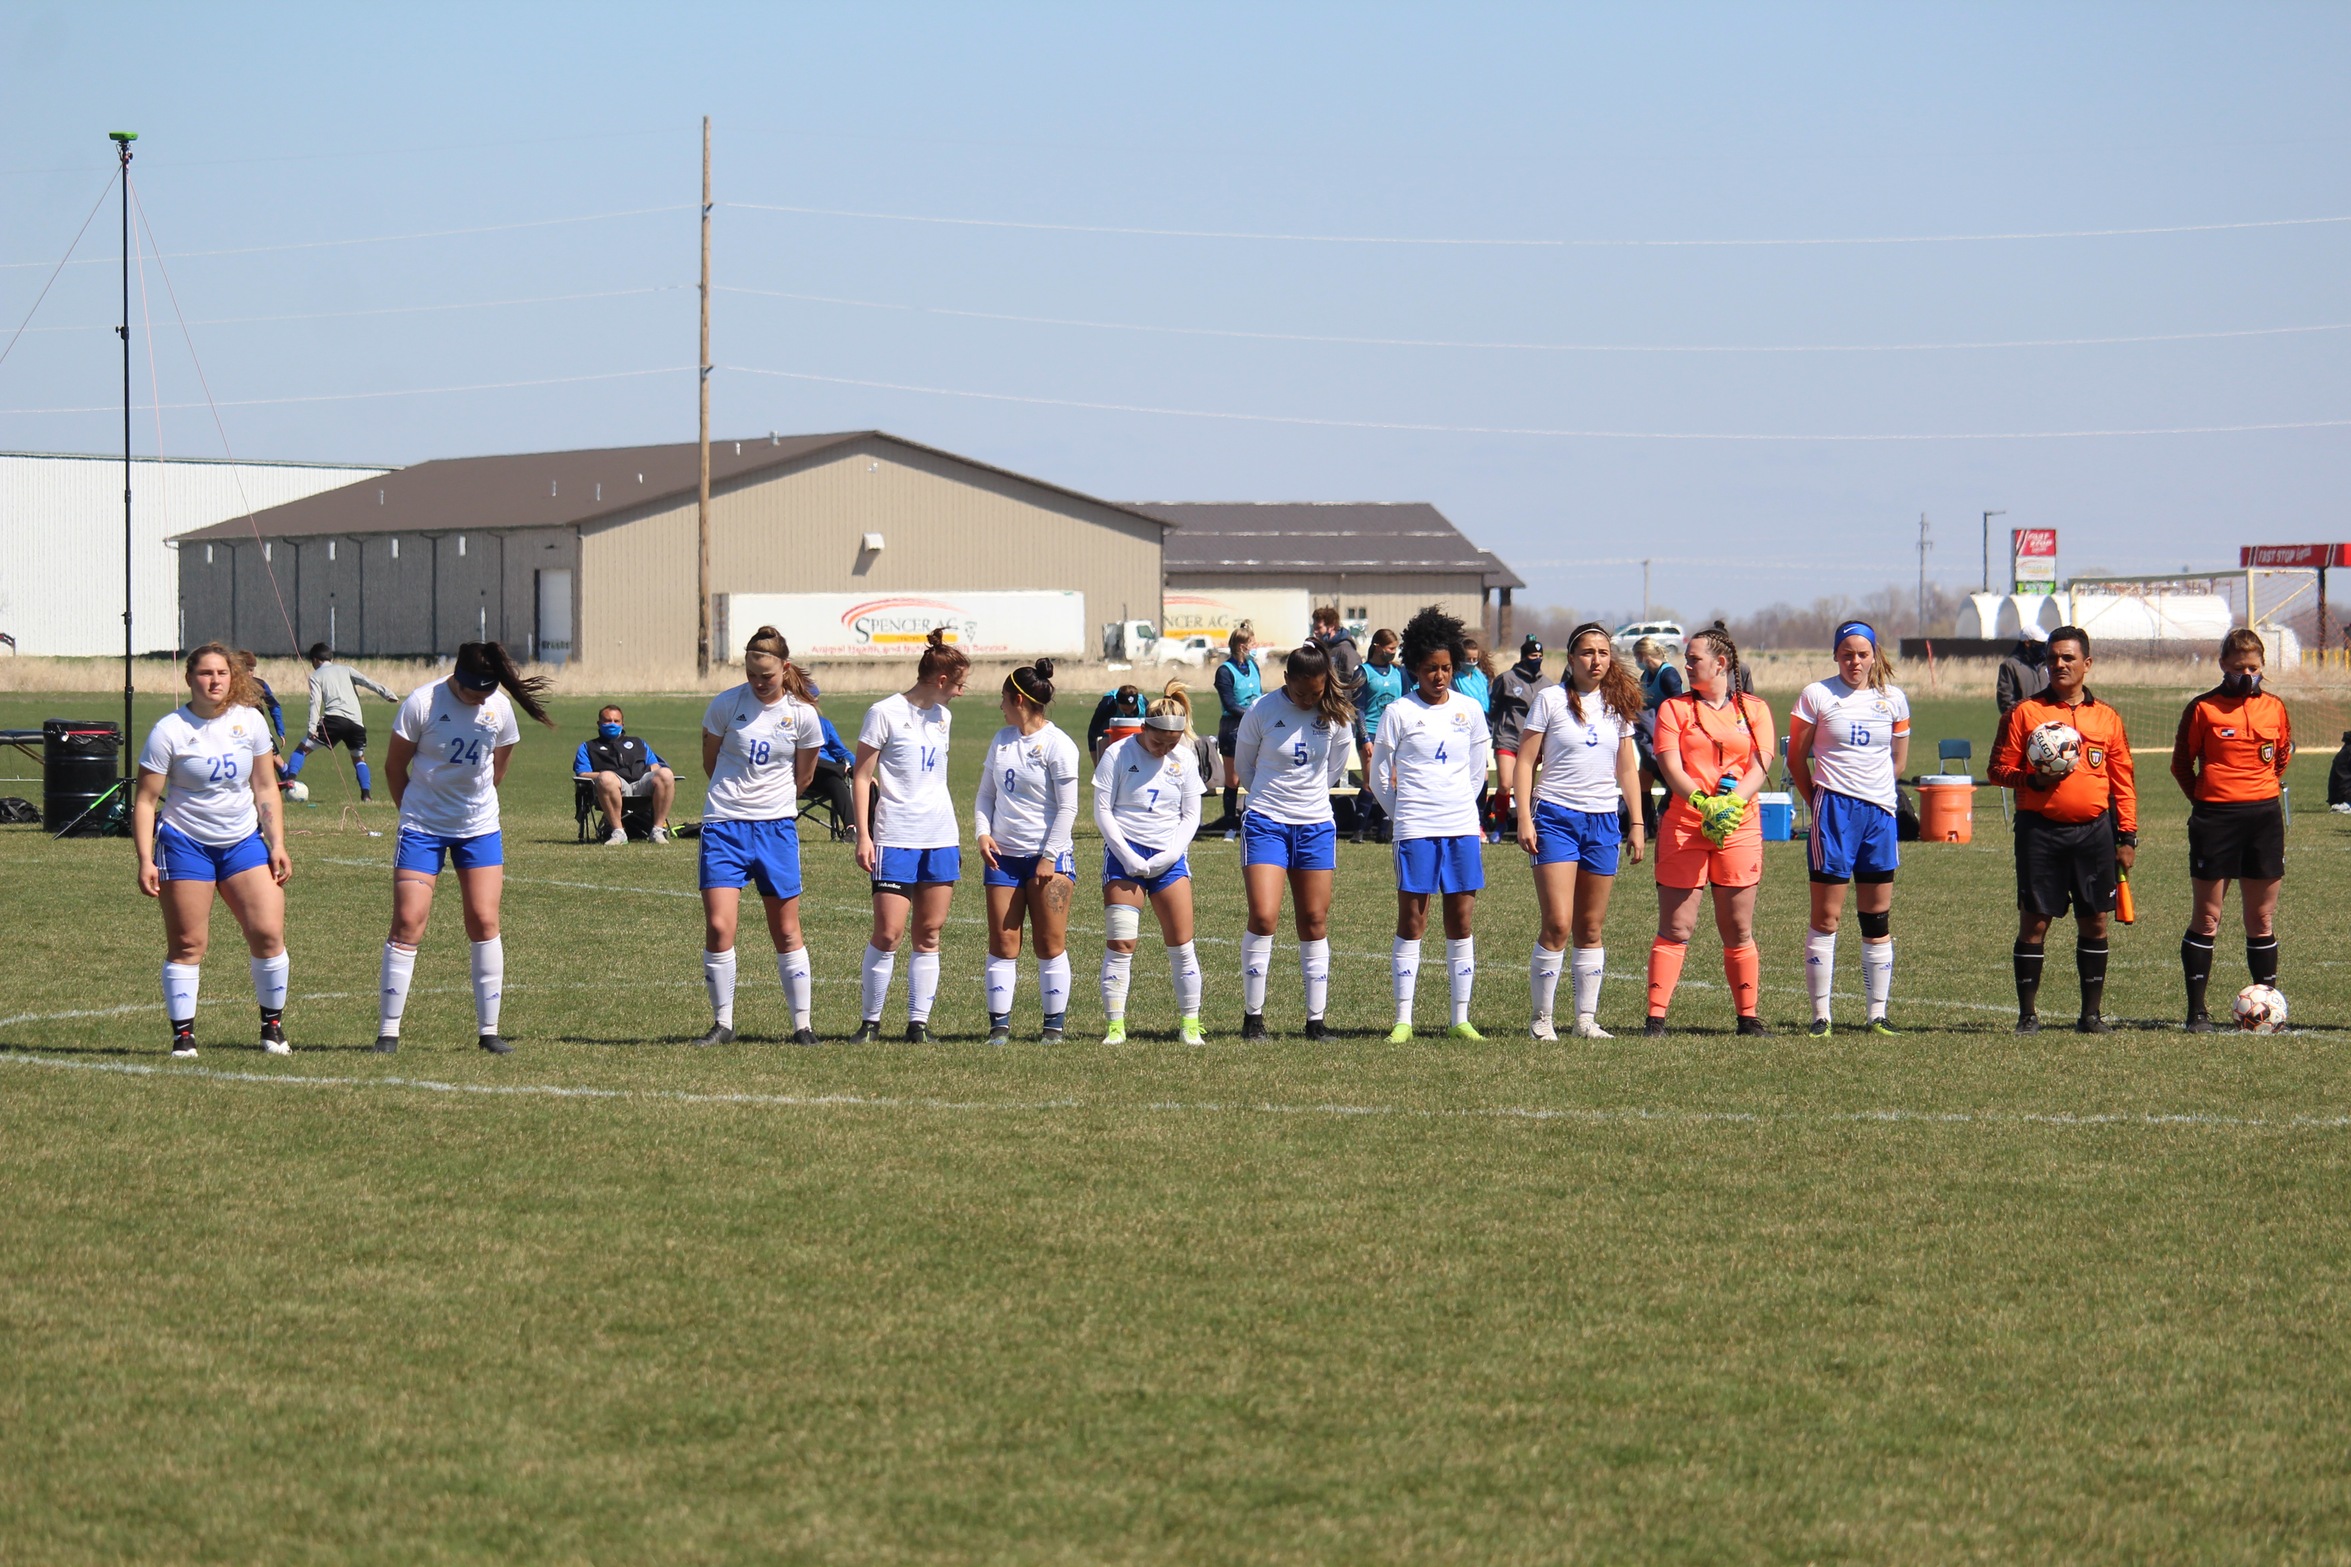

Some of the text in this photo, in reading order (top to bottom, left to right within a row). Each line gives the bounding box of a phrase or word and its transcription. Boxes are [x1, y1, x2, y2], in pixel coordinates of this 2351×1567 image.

[2258, 549, 2277, 563] FAST
[2276, 549, 2295, 563] STOP
[855, 617, 931, 644] SPENCER
[1163, 614, 1229, 628] NCER AG
[1585, 724, 1597, 747] 3
[1850, 721, 1870, 746] 15
[2035, 731, 2054, 759] SELECT
[449, 737, 479, 765] 24
[749, 739, 771, 765] 18
[921, 745, 936, 772] 14
[1294, 743, 1308, 766] 5
[1435, 740, 1448, 764] 4
[207, 753, 237, 782] 25
[1004, 768, 1015, 793] 8
[1147, 789, 1160, 812] 7
